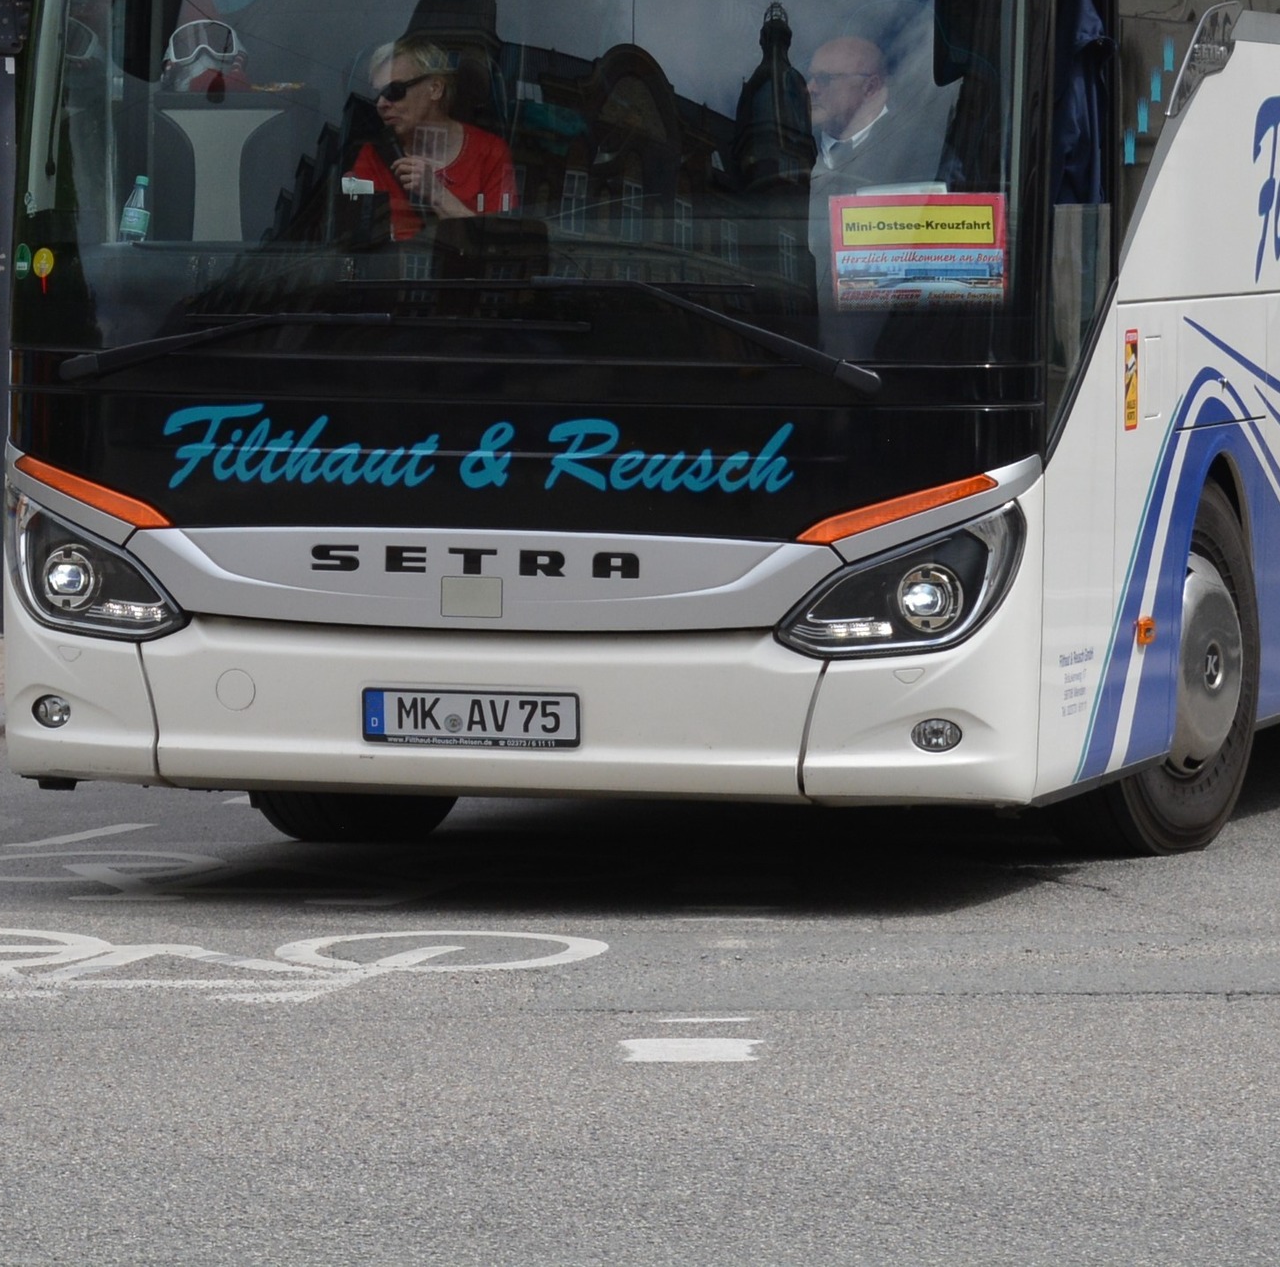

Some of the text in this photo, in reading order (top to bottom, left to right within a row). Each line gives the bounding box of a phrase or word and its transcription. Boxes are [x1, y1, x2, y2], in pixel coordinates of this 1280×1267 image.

[845, 220, 991, 233] Mini-Ostsee-Kreuzfahrt
[841, 251, 888, 265] Herzlich
[891, 251, 956, 264] willkommen
[959, 253, 974, 262] an
[163, 402, 795, 494] Filthaut & Reusch
[310, 544, 640, 579] SETRA
[1205, 655, 1218, 675] K
[370, 717, 378, 727] D
[396, 696, 561, 734] MK AV 75
